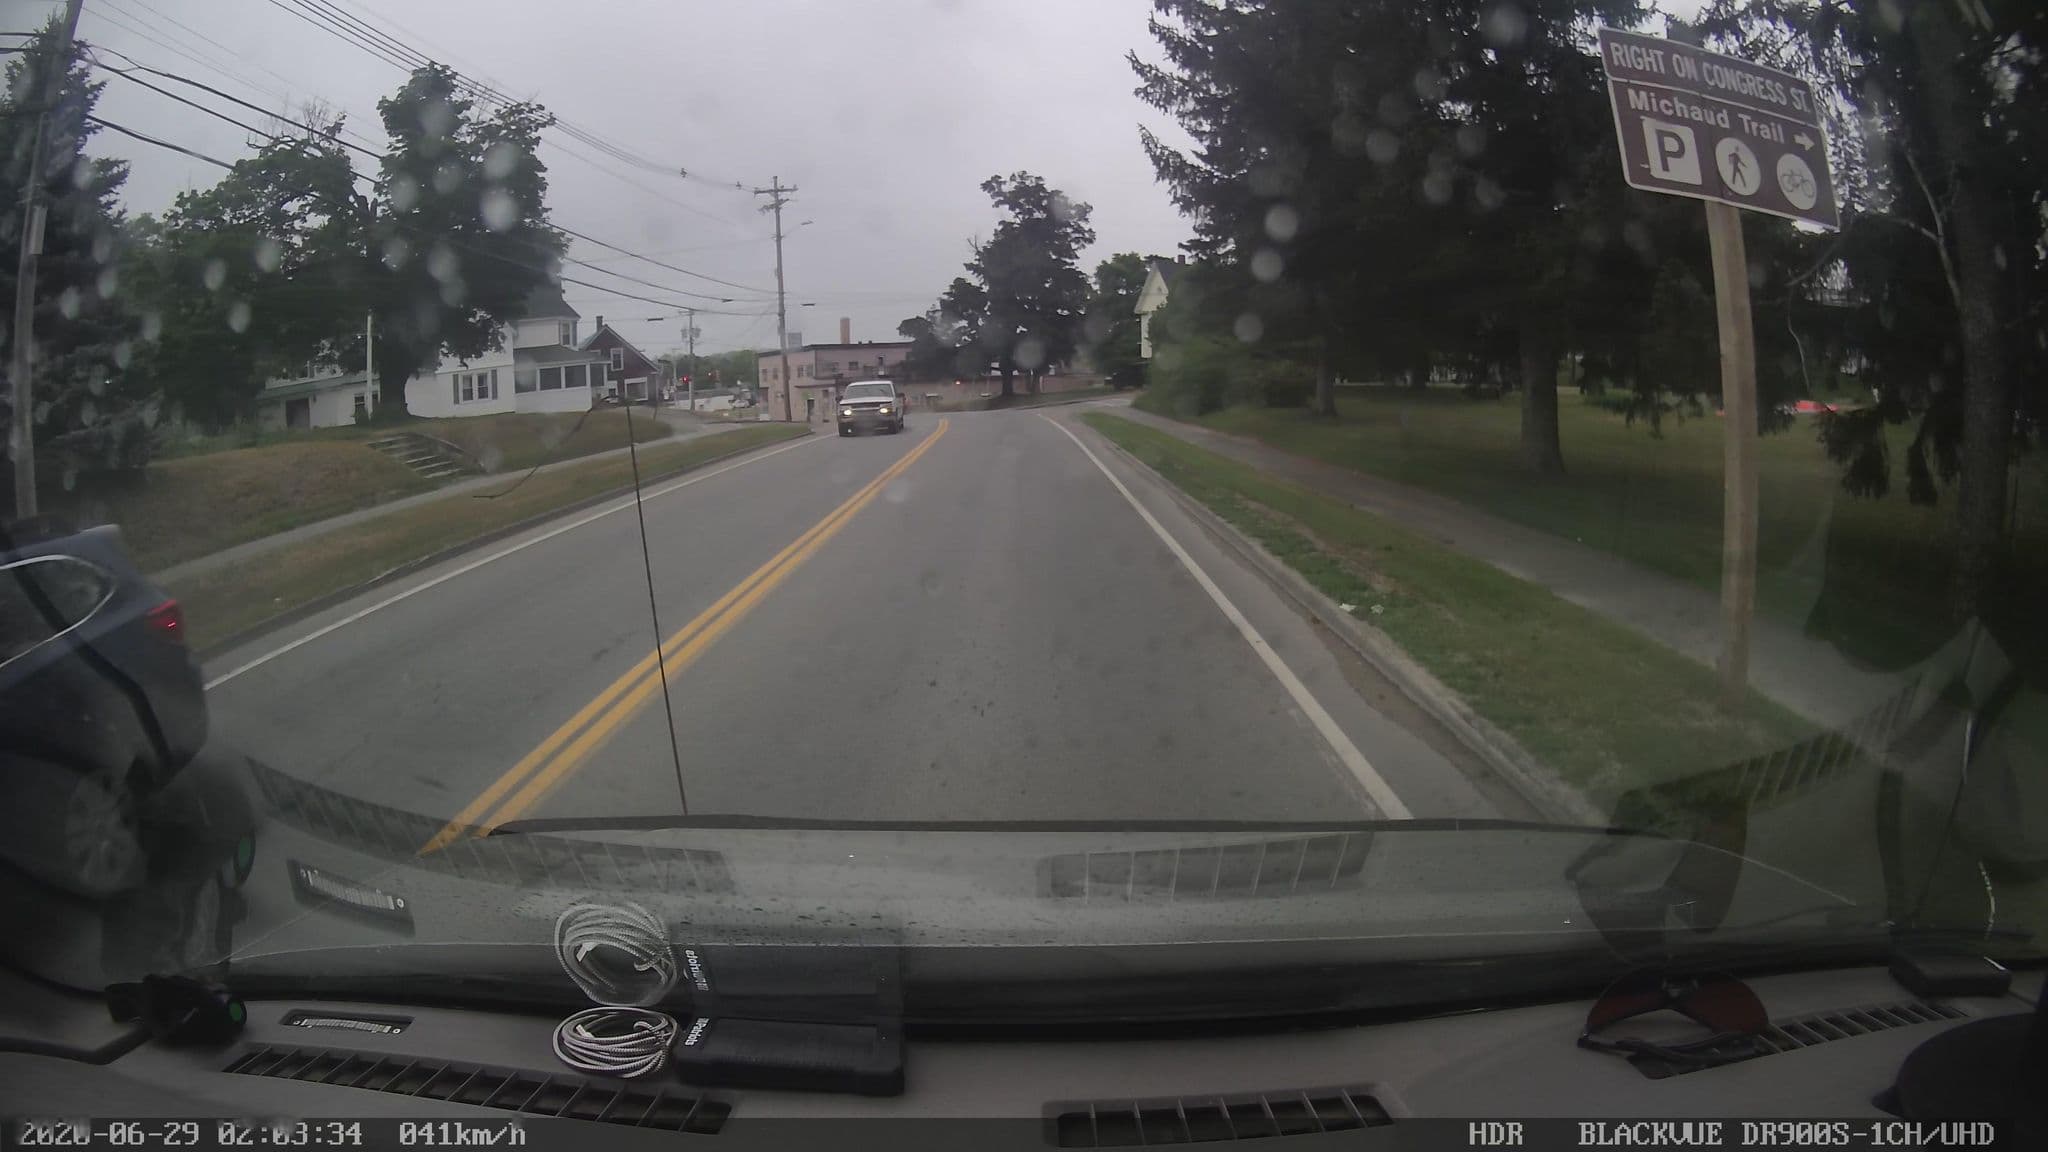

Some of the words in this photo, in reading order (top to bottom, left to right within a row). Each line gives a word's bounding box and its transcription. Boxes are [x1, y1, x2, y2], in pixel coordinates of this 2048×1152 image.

[1609, 42, 1665, 75] RIGHT
[1672, 53, 1699, 82] ON
[1703, 62, 1787, 106] CONGRESS
[1627, 88, 1730, 129] Michaud
[1738, 113, 1785, 144] Trail
[1655, 129, 1687, 173] P
